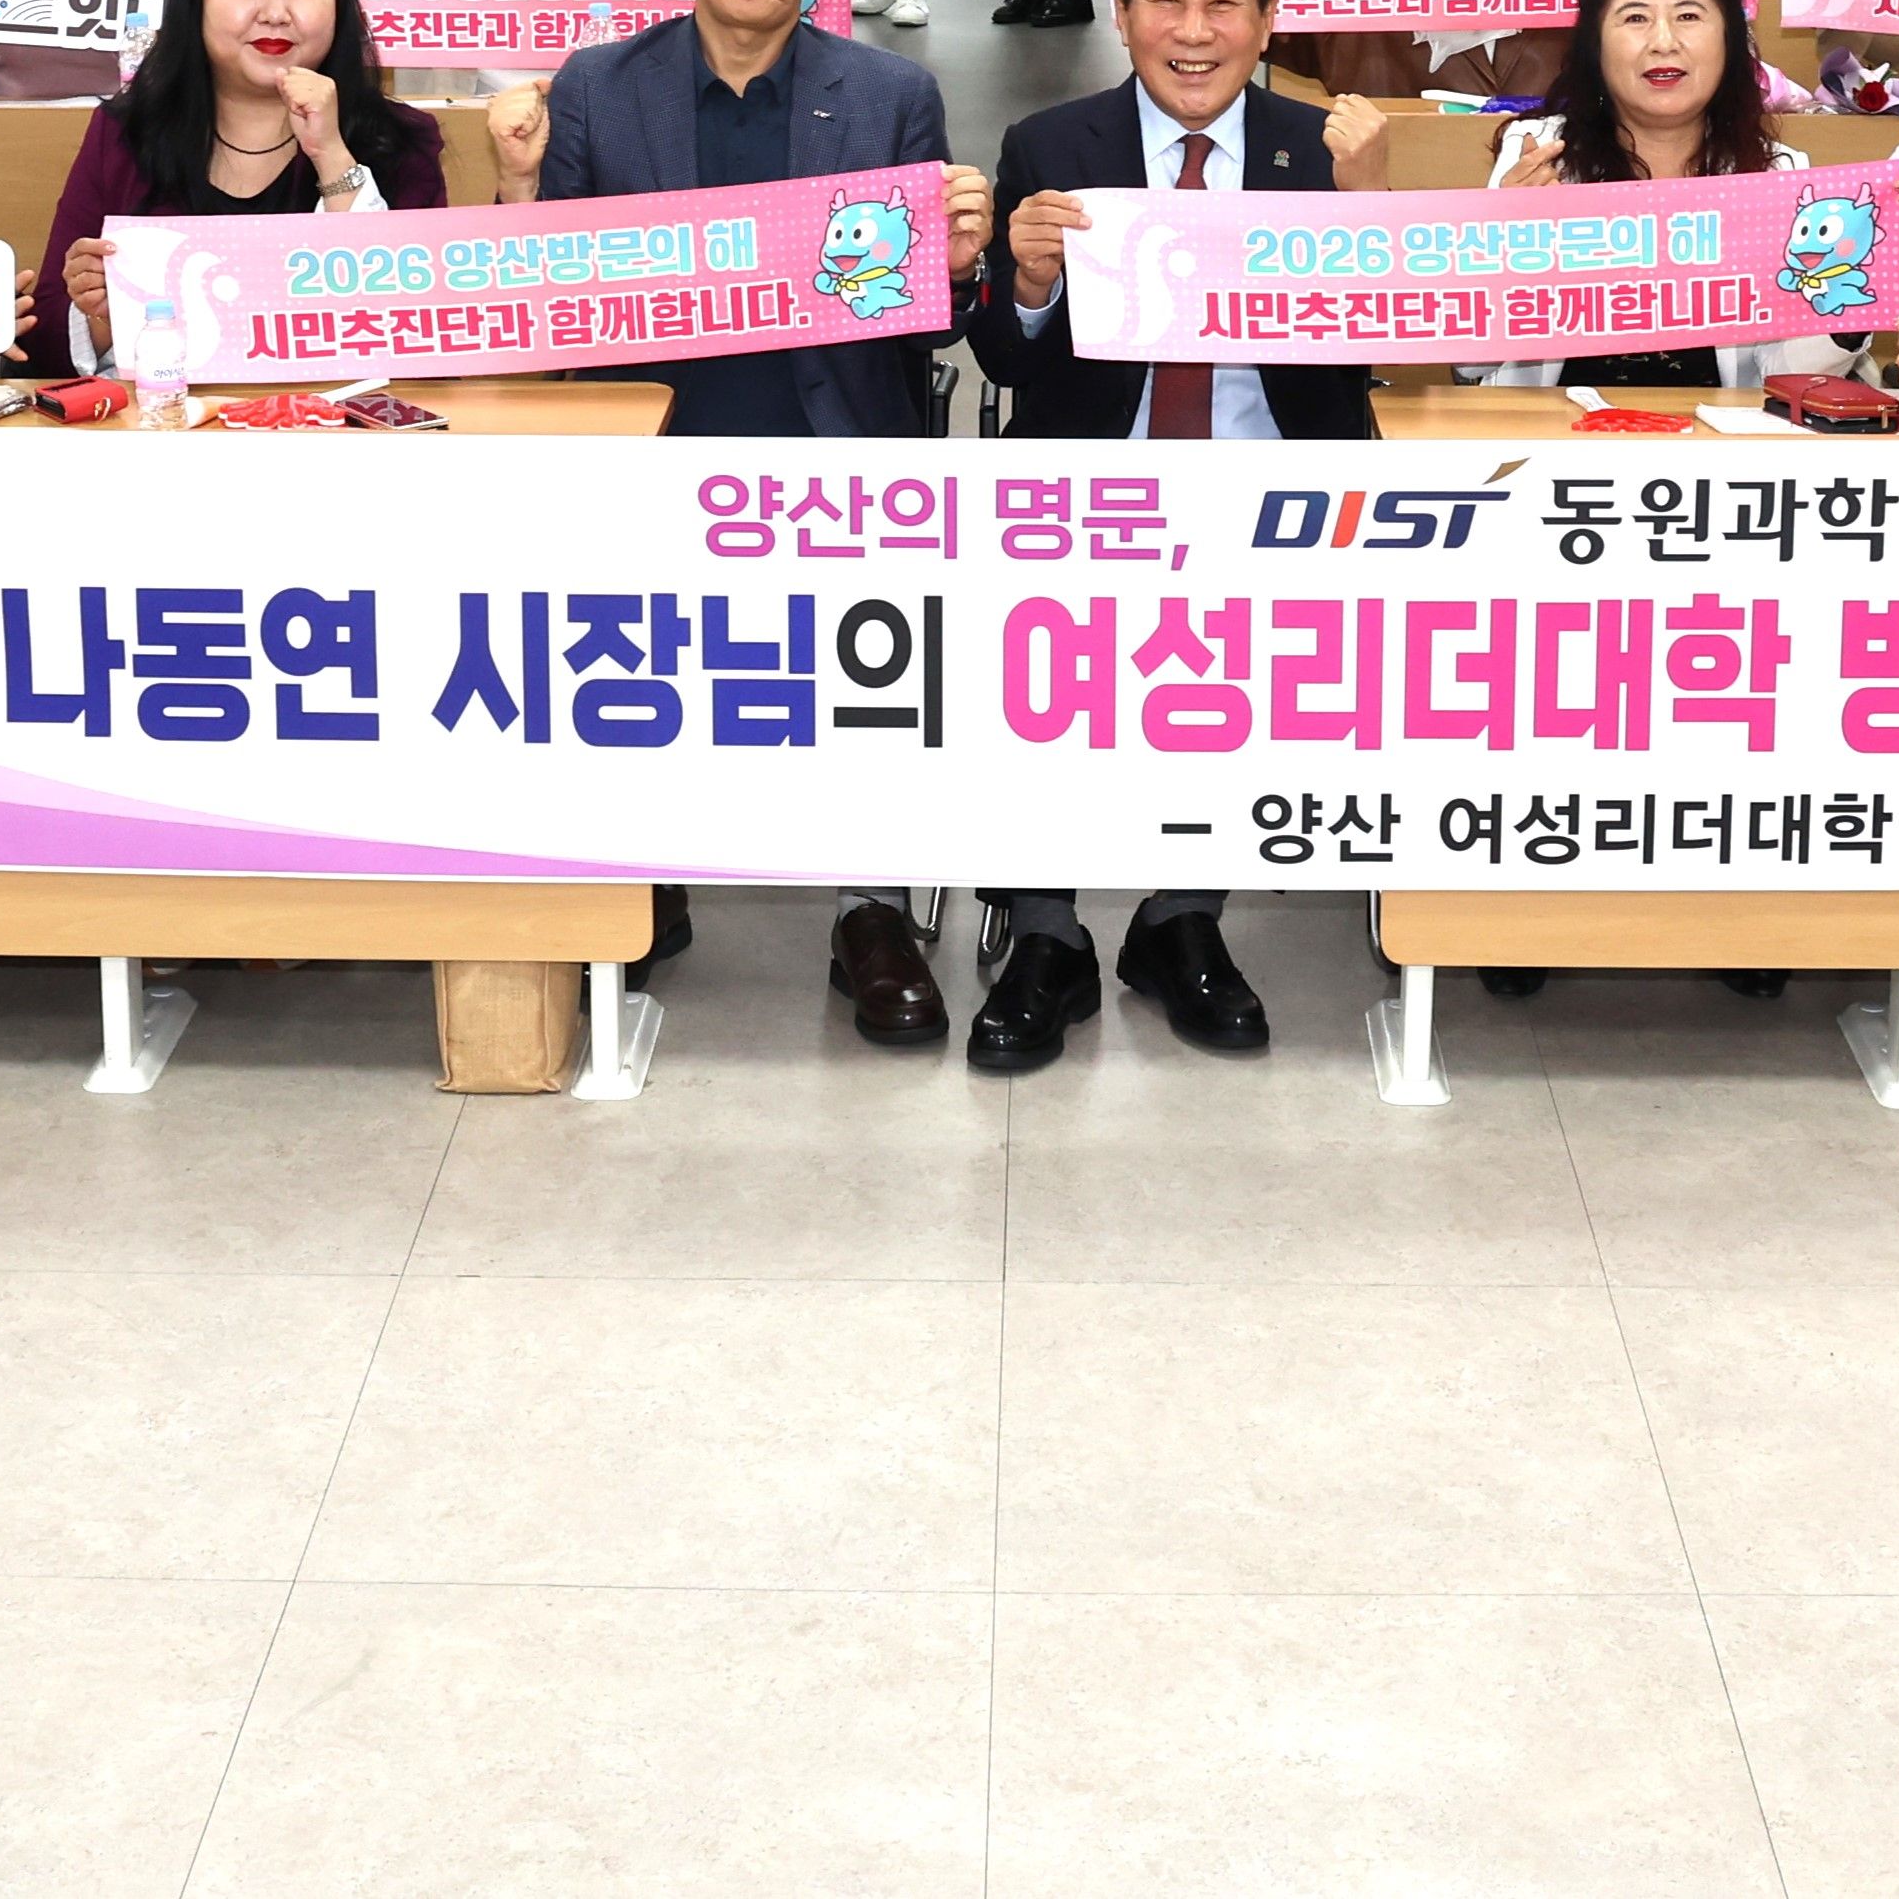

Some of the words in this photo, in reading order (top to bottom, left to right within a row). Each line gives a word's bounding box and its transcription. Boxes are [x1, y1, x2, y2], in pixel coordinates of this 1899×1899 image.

[287, 247, 433, 295] 2026
[443, 227, 692, 294] 양산방문의
[708, 220, 755, 272] 해
[1245, 227, 1390, 276] 2026
[1404, 216, 1656, 272] 양산방문의
[1672, 212, 1718, 262] 해
[250, 301, 536, 361] 시민추진단과
[550, 280, 810, 346] 함께합니다.
[1199, 287, 1491, 341] 시민추진단과
[1506, 276, 1770, 337] 함께합니다.
[700, 475, 959, 560] 양산의
[996, 477, 1190, 571] 명문,
[1250, 468, 1520, 550] DIST
[2, 586, 380, 741] 나동연
[431, 591, 941, 748] 시장님의
[1004, 594, 1791, 754] 여성리더대학
[1252, 793, 1403, 866] 양산
[1437, 794, 1892, 866] 여성리더대학
